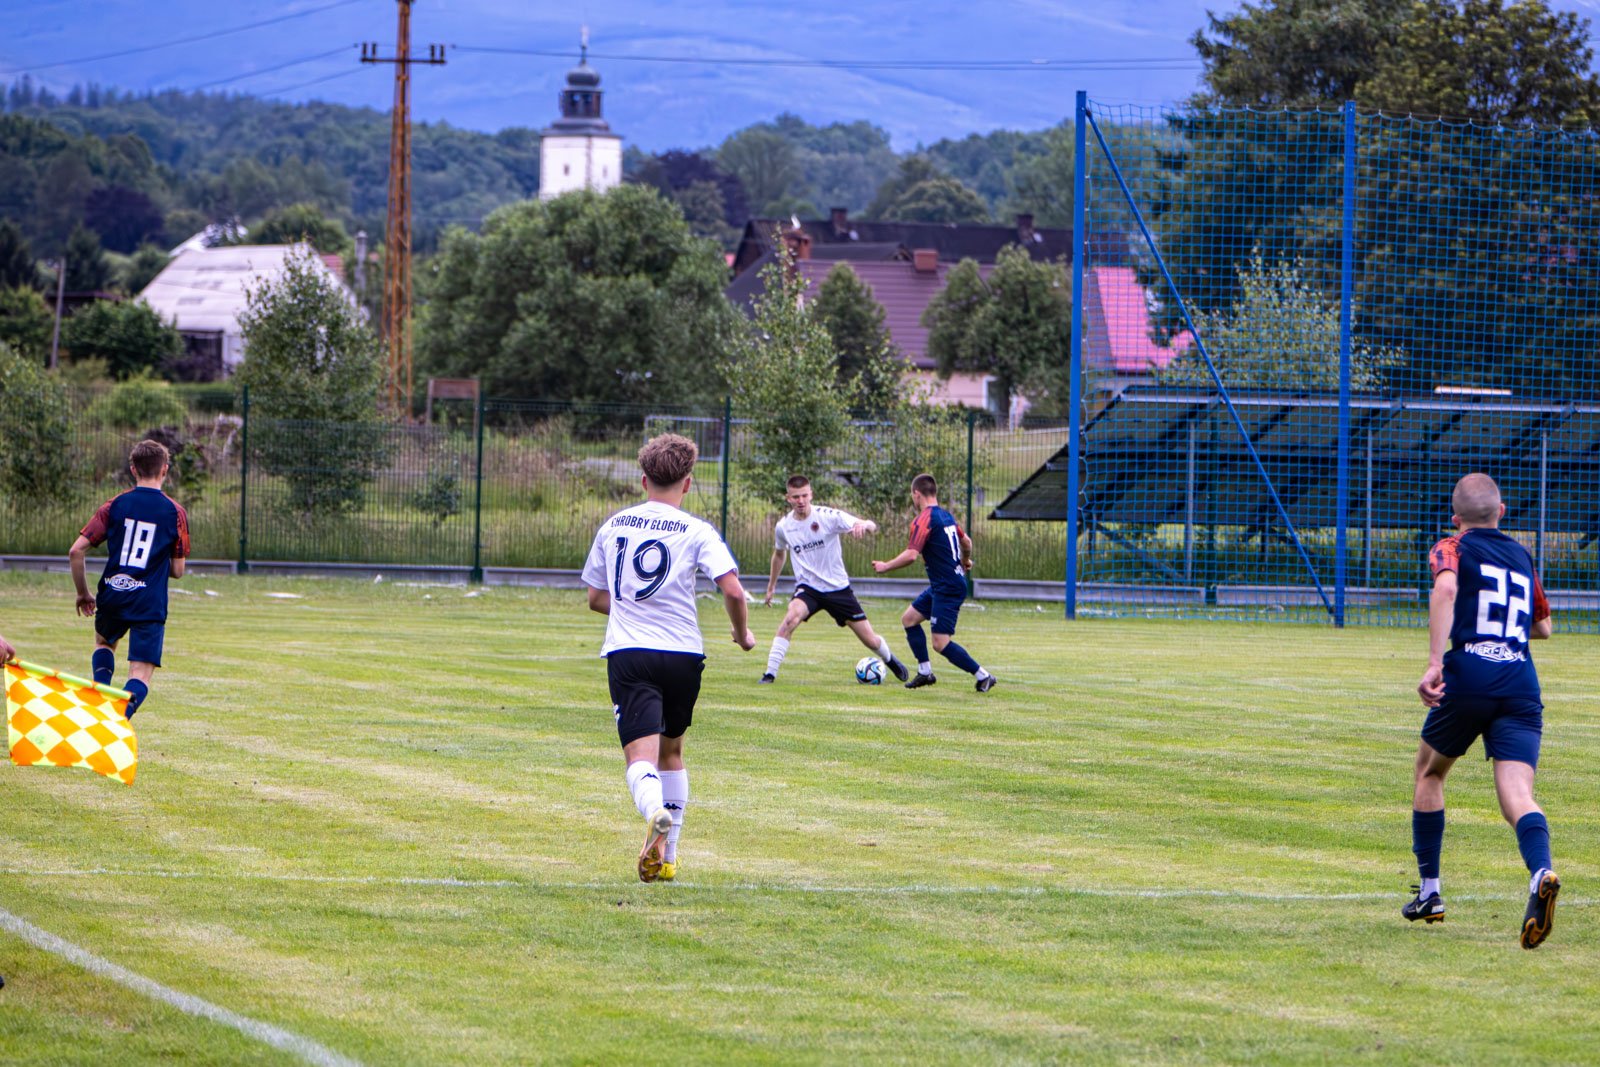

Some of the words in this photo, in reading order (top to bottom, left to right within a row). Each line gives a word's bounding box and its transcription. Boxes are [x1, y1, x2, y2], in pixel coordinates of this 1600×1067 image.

[119, 517, 157, 569] 18
[611, 515, 650, 530] CHROBRY
[650, 519, 689, 534] GŁOGÓW
[802, 539, 824, 551] KGHM
[943, 524, 961, 562] 17
[614, 536, 671, 602] 19
[1476, 563, 1531, 643] 22
